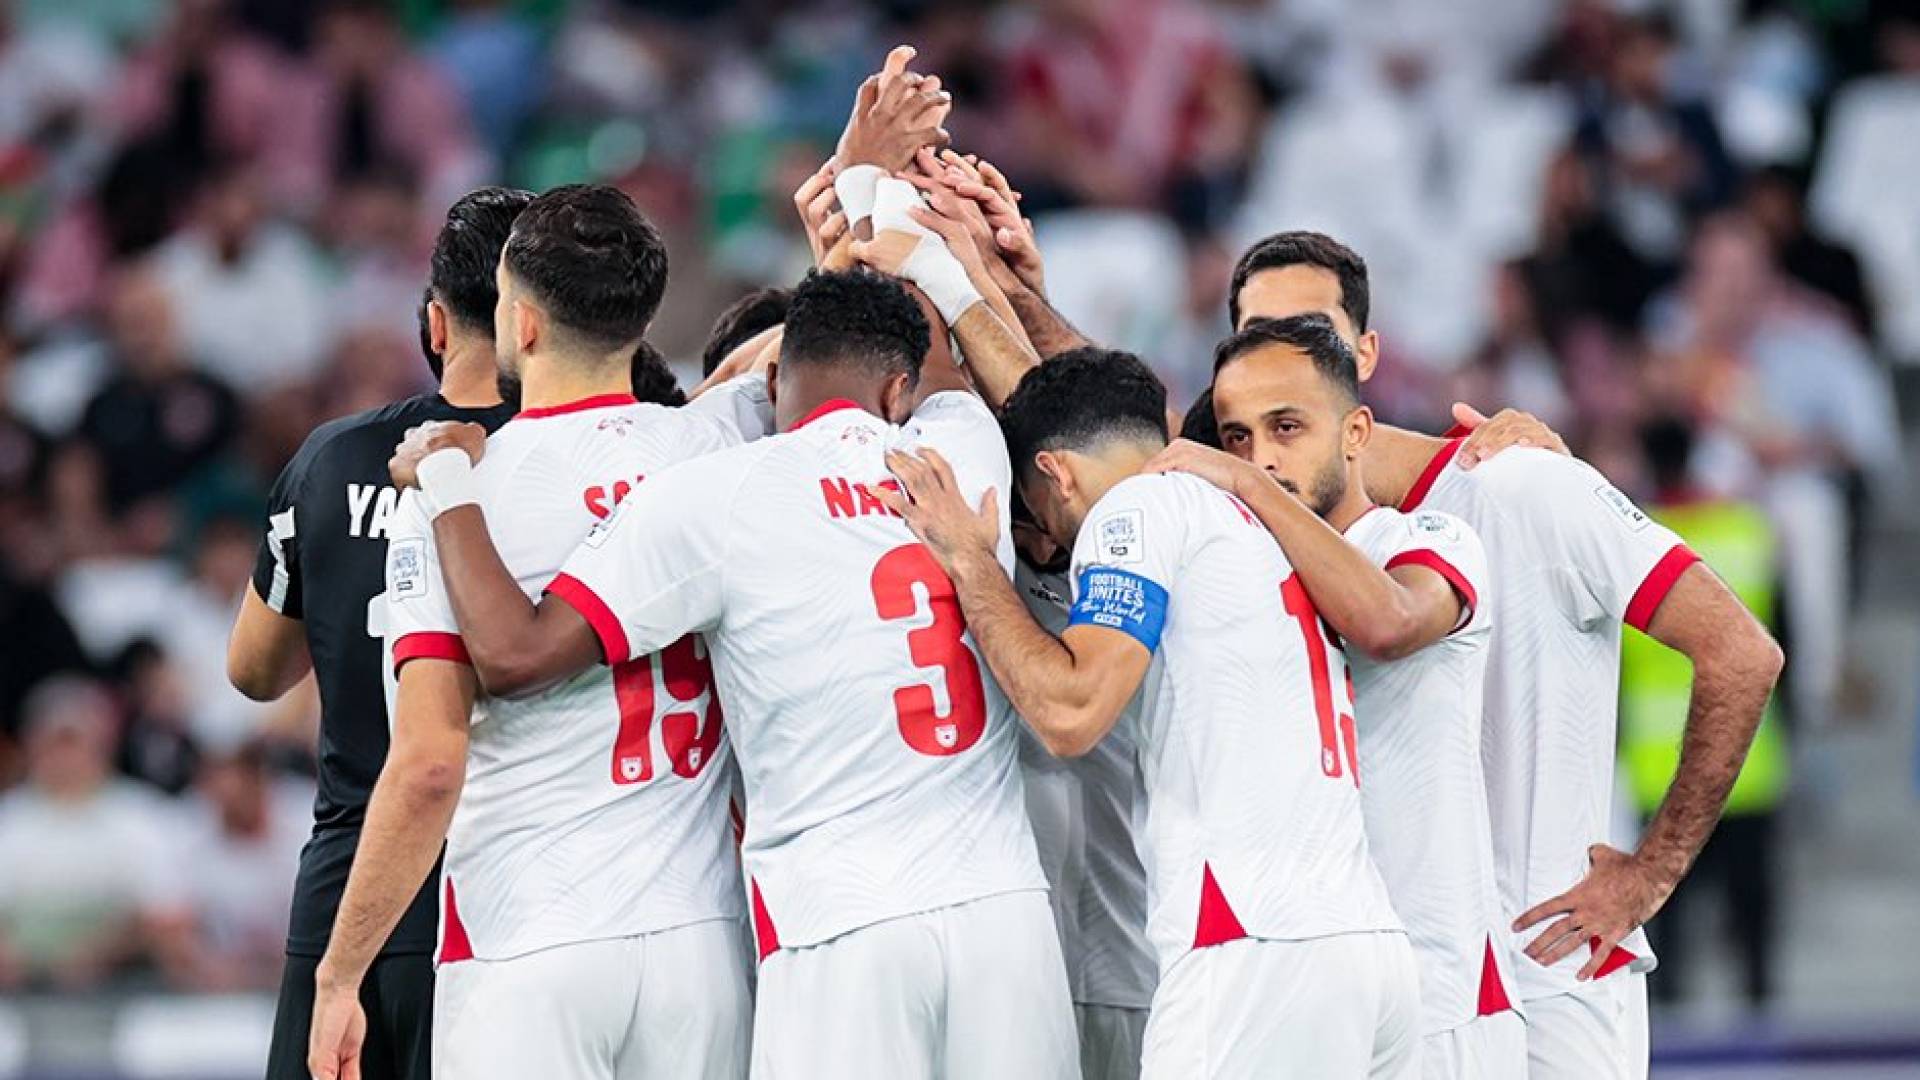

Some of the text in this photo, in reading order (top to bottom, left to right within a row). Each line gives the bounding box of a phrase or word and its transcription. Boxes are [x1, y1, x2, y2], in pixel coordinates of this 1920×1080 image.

[347, 484, 398, 538] YA
[1087, 587, 1144, 608] UNITES
[1090, 573, 1142, 591] FOOTBALL
[871, 542, 986, 756] 3
[611, 633, 723, 785] 19
